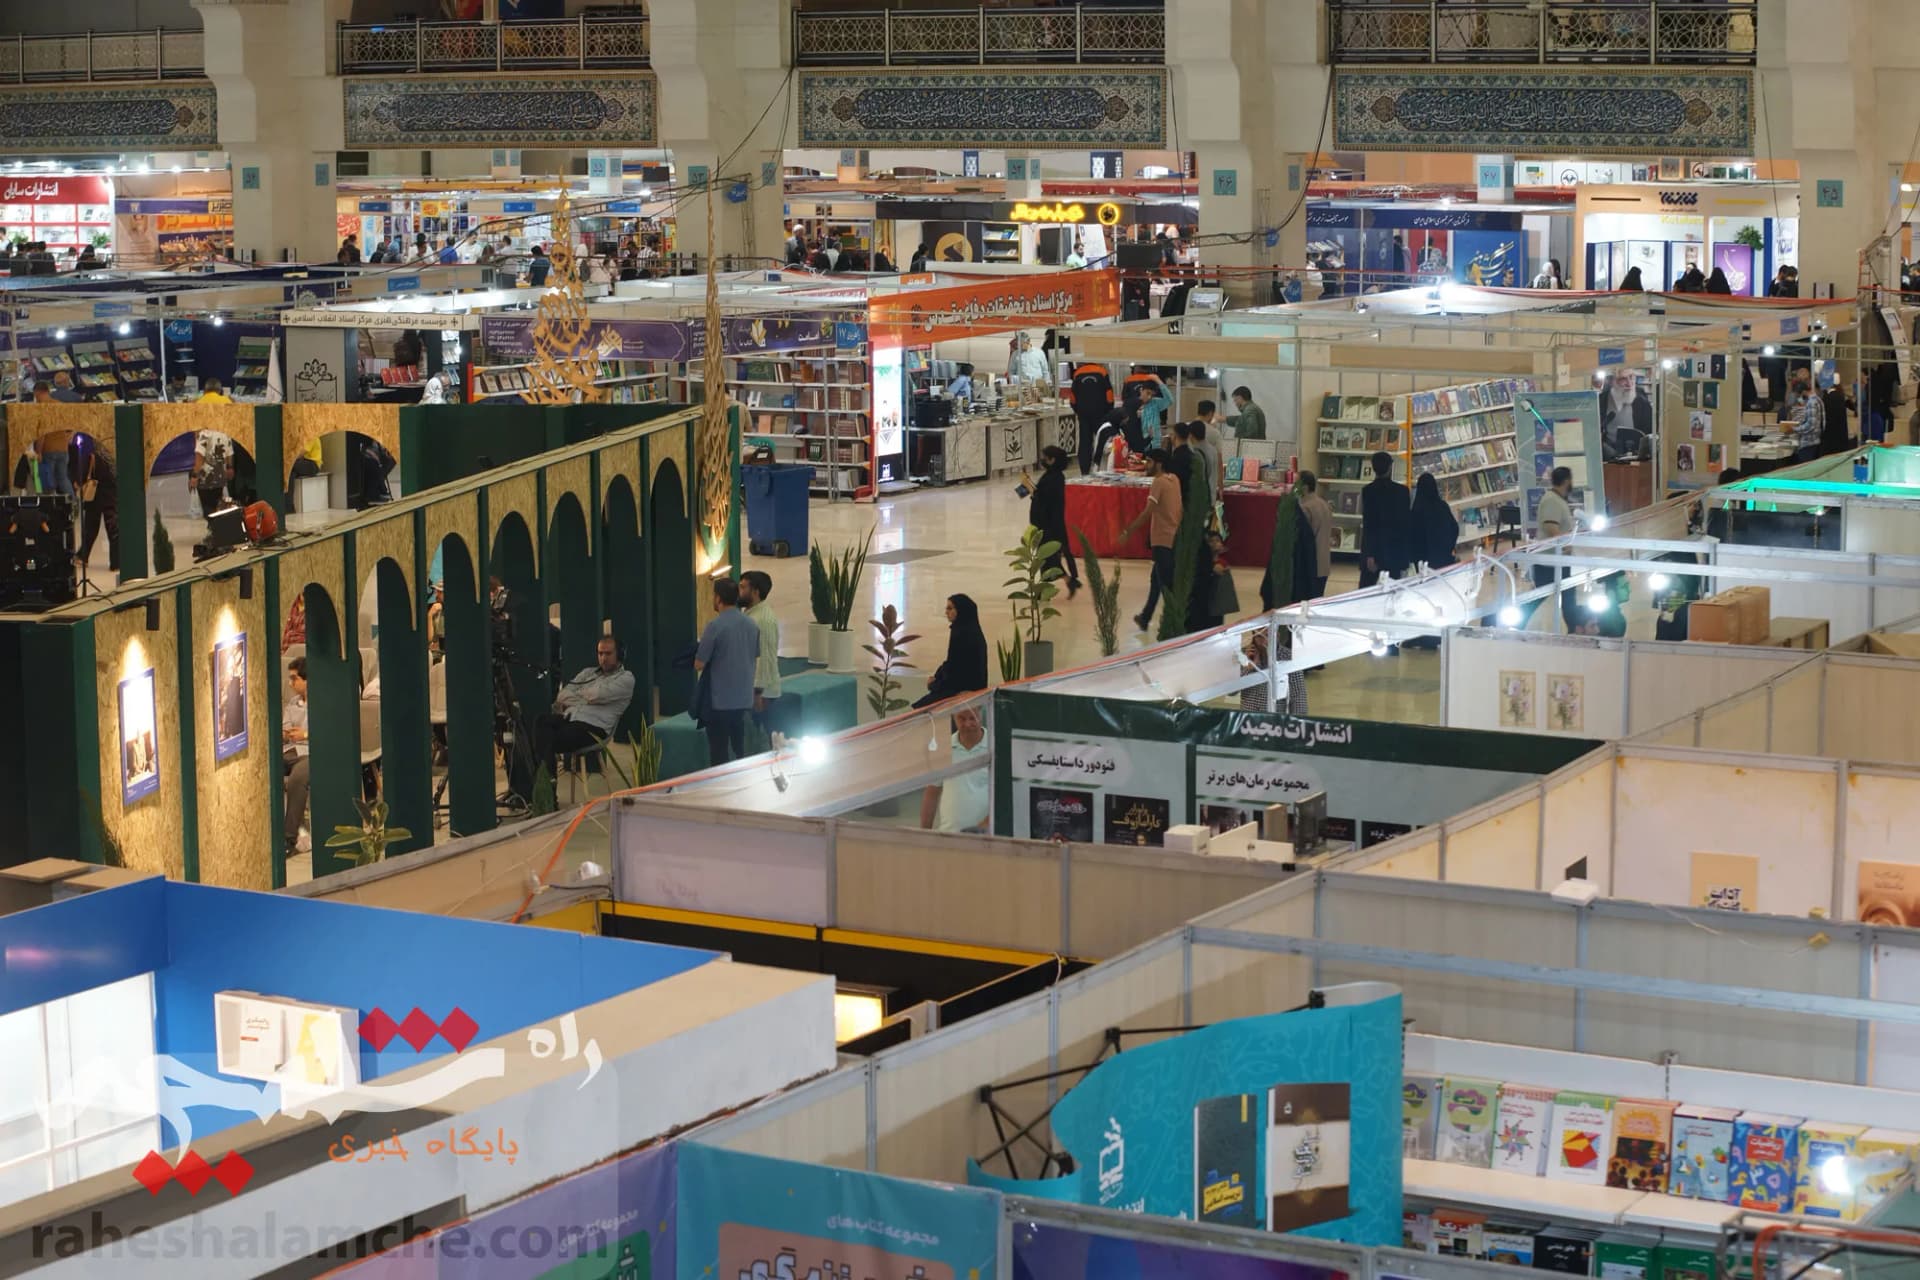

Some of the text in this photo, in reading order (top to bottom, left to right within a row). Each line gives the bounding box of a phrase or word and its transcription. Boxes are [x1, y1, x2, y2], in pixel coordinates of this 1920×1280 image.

[4, 181, 58, 200] انتشارات سایان
[987, 295, 1025, 320] تحقیقات
[1025, 300, 1031, 312] و
[1031, 292, 1055, 312] اسناد
[1056, 291, 1073, 313] مرکز
[292, 314, 315, 324] اسلامی
[317, 314, 337, 322] انقلاب
[338, 314, 356, 324] اسناد
[358, 315, 372, 325] مرکز
[1240, 717, 1352, 746] انتشارات مجید
[1027, 754, 1116, 774] فئودور داستایفسکی
[1271, 777, 1310, 792] مجموعه
[886, 1224, 939, 1246] مجموعه
